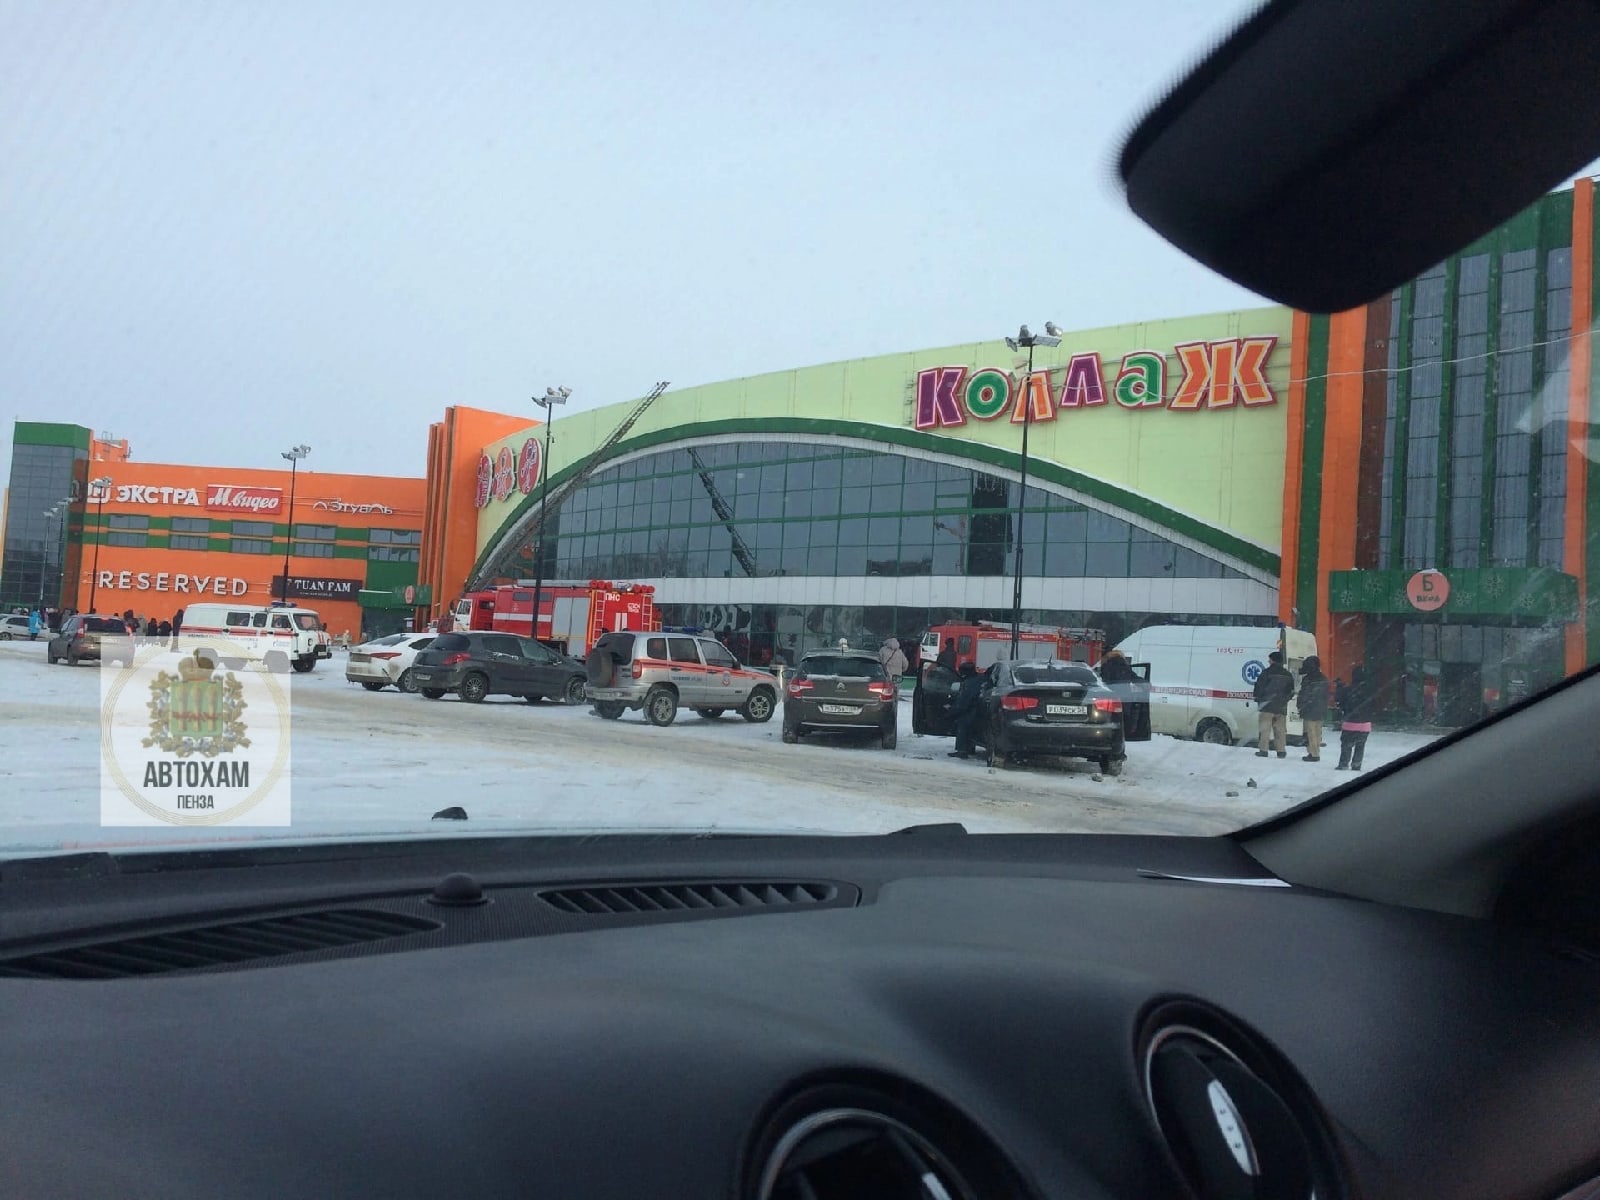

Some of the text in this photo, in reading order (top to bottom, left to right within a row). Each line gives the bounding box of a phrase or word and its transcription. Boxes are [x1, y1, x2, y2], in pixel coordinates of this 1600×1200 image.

[116, 485, 200, 505] ЭКСТРА
[99, 570, 248, 596] RESERVED
[294, 579, 325, 591] TUAN
